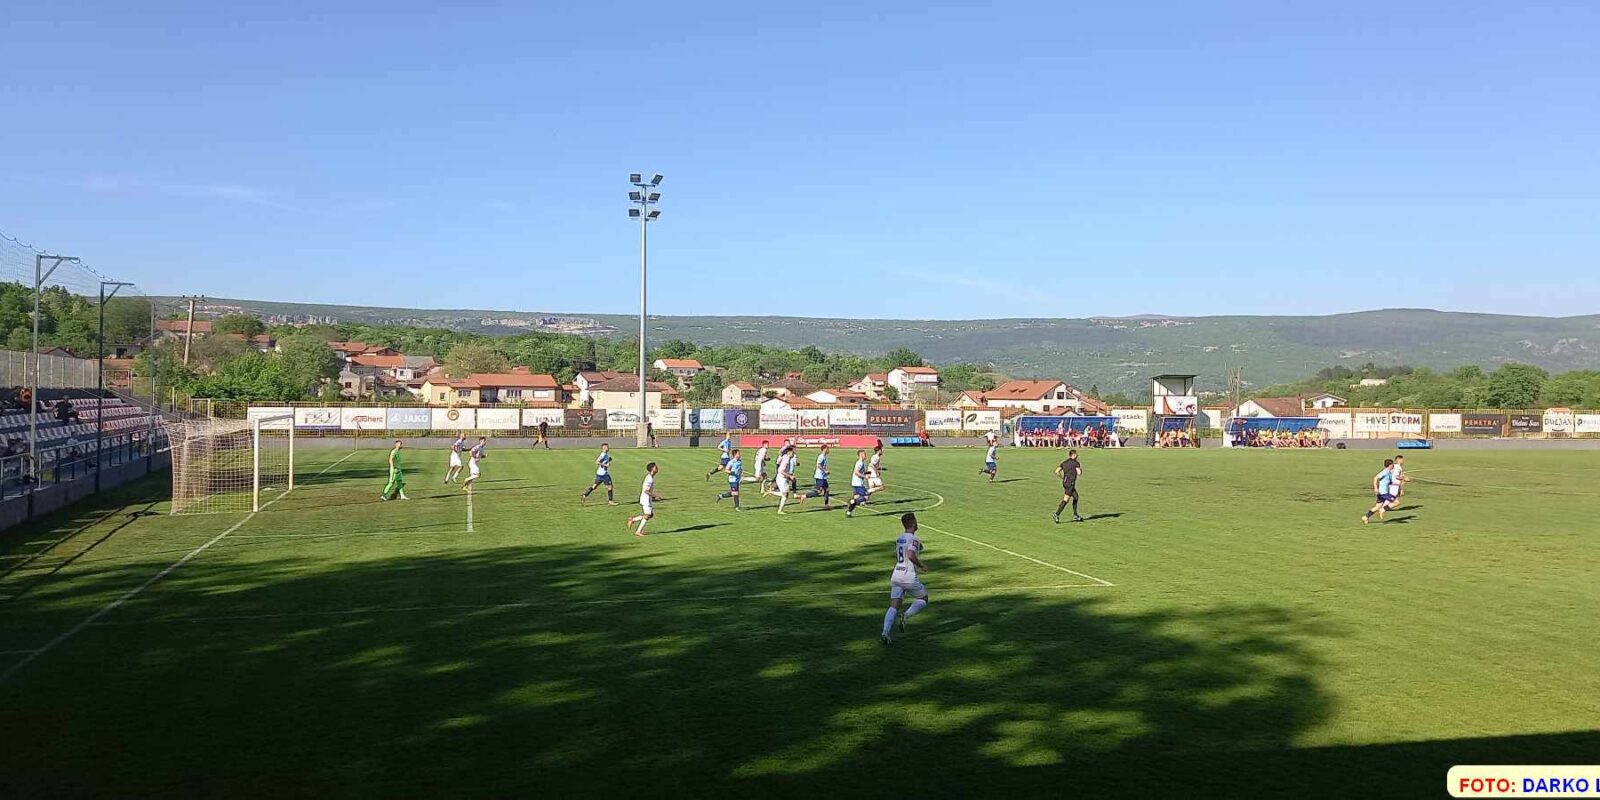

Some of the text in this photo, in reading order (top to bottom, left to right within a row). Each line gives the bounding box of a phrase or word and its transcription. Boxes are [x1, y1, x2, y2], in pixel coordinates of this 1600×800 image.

[403, 415, 428, 423] JAKO
[800, 416, 826, 427] leda
[1366, 416, 1387, 424] HIVE
[1391, 416, 1420, 424] STORM
[898, 546, 904, 563] 8
